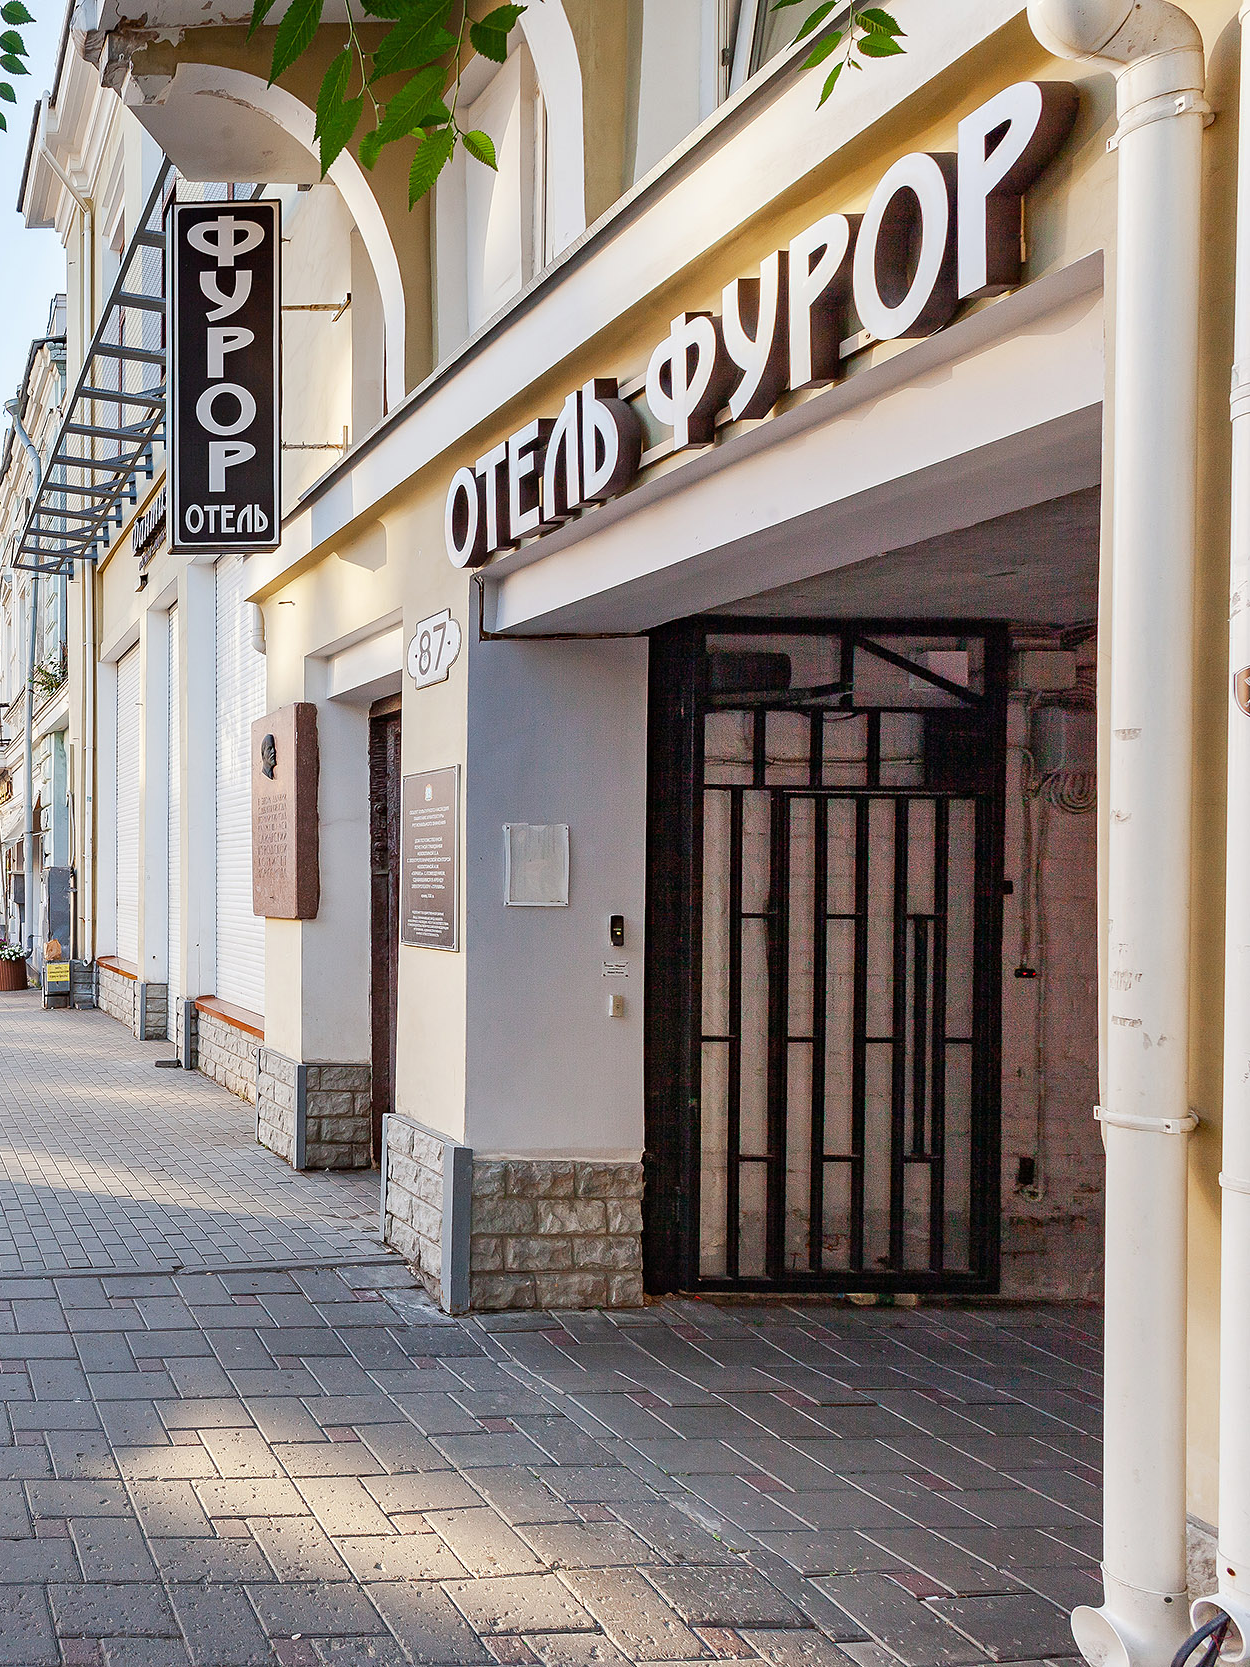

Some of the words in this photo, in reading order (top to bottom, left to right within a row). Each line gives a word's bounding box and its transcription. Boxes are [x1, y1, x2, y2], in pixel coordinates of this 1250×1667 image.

[187, 215, 265, 492] ФУРОР
[445, 378, 636, 569] ОТЕЛЬ
[645, 81, 1066, 450] ФУРОР
[185, 504, 269, 534] ОТЕЛЬ
[419, 621, 447, 676] 87
